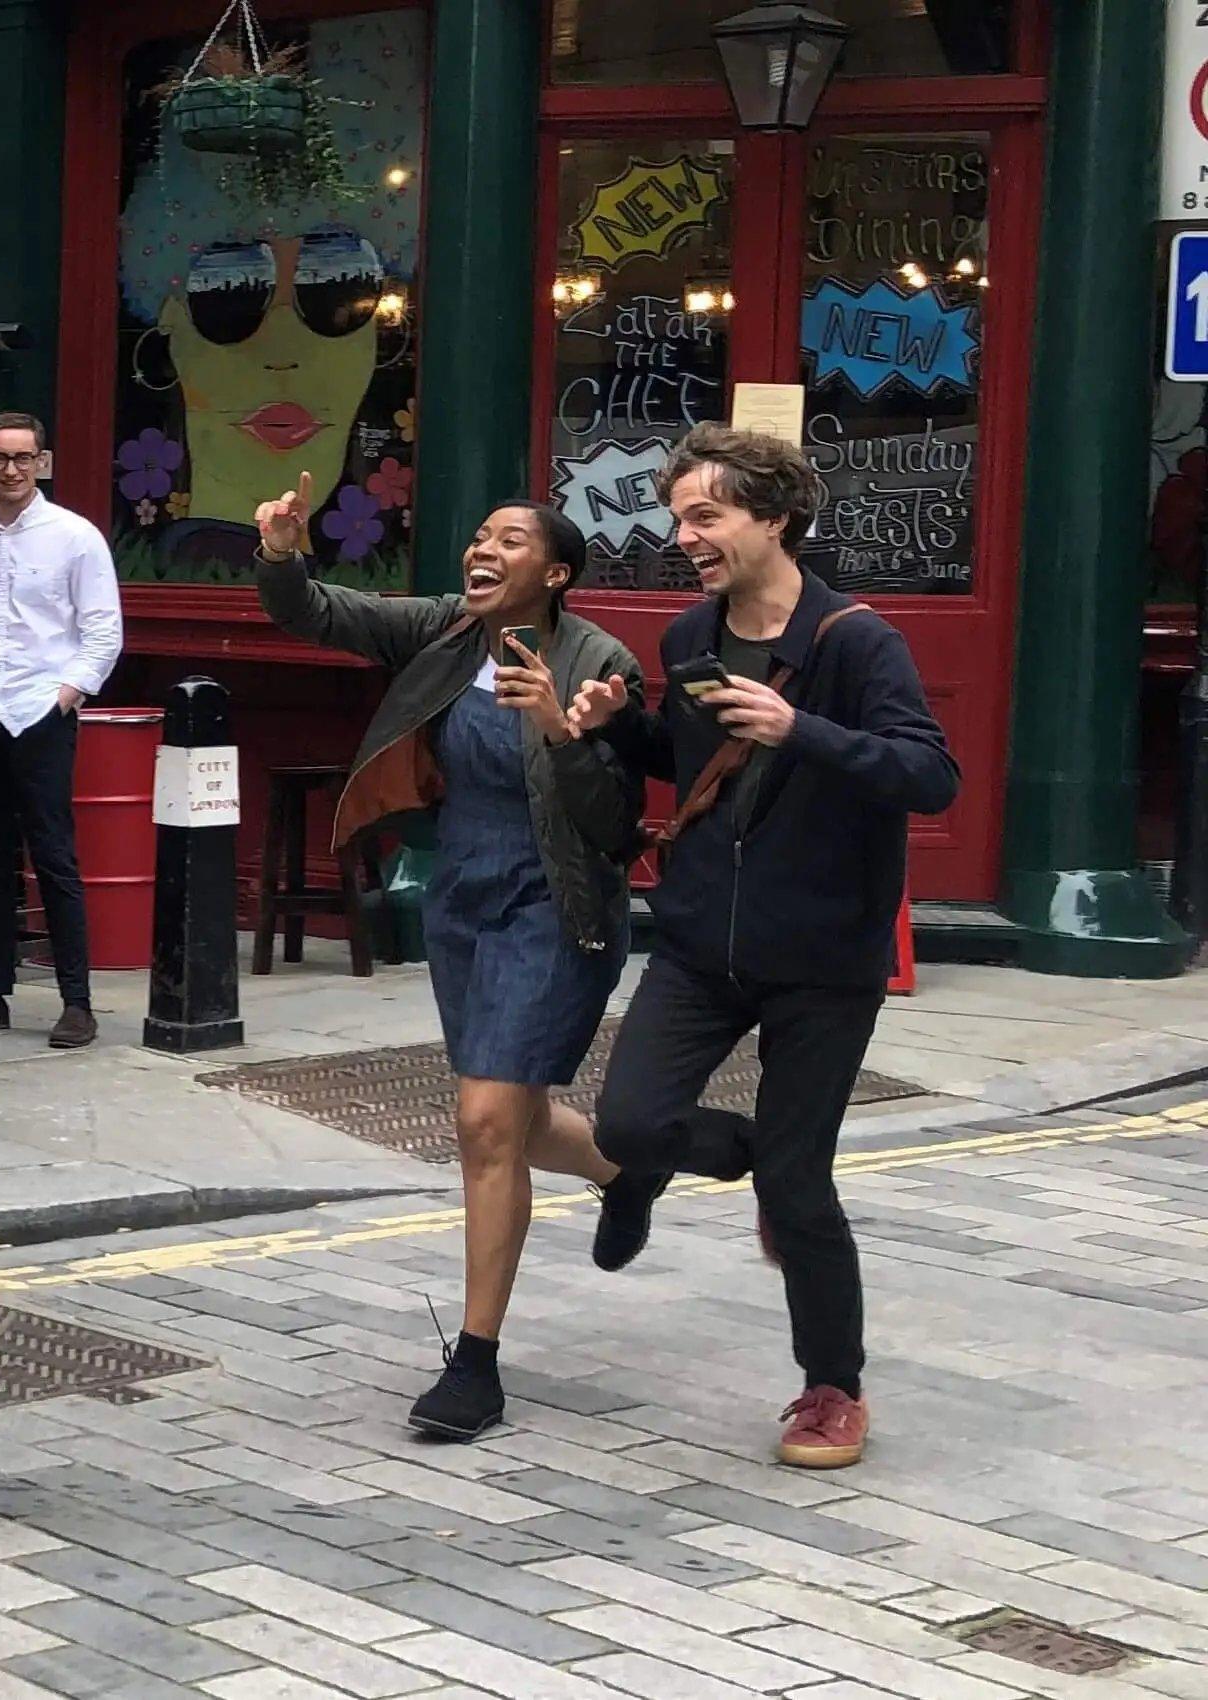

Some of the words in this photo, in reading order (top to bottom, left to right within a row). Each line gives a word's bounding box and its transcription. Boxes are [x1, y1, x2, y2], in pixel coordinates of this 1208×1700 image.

[594, 160, 704, 252] NEW
[806, 211, 984, 263] Dining
[615, 341, 678, 369] THE
[822, 304, 945, 373] NEW
[559, 372, 719, 436] CHEF
[807, 414, 973, 499] Sunday
[588, 469, 659, 522] NE
[198, 760, 231, 773] CITY
